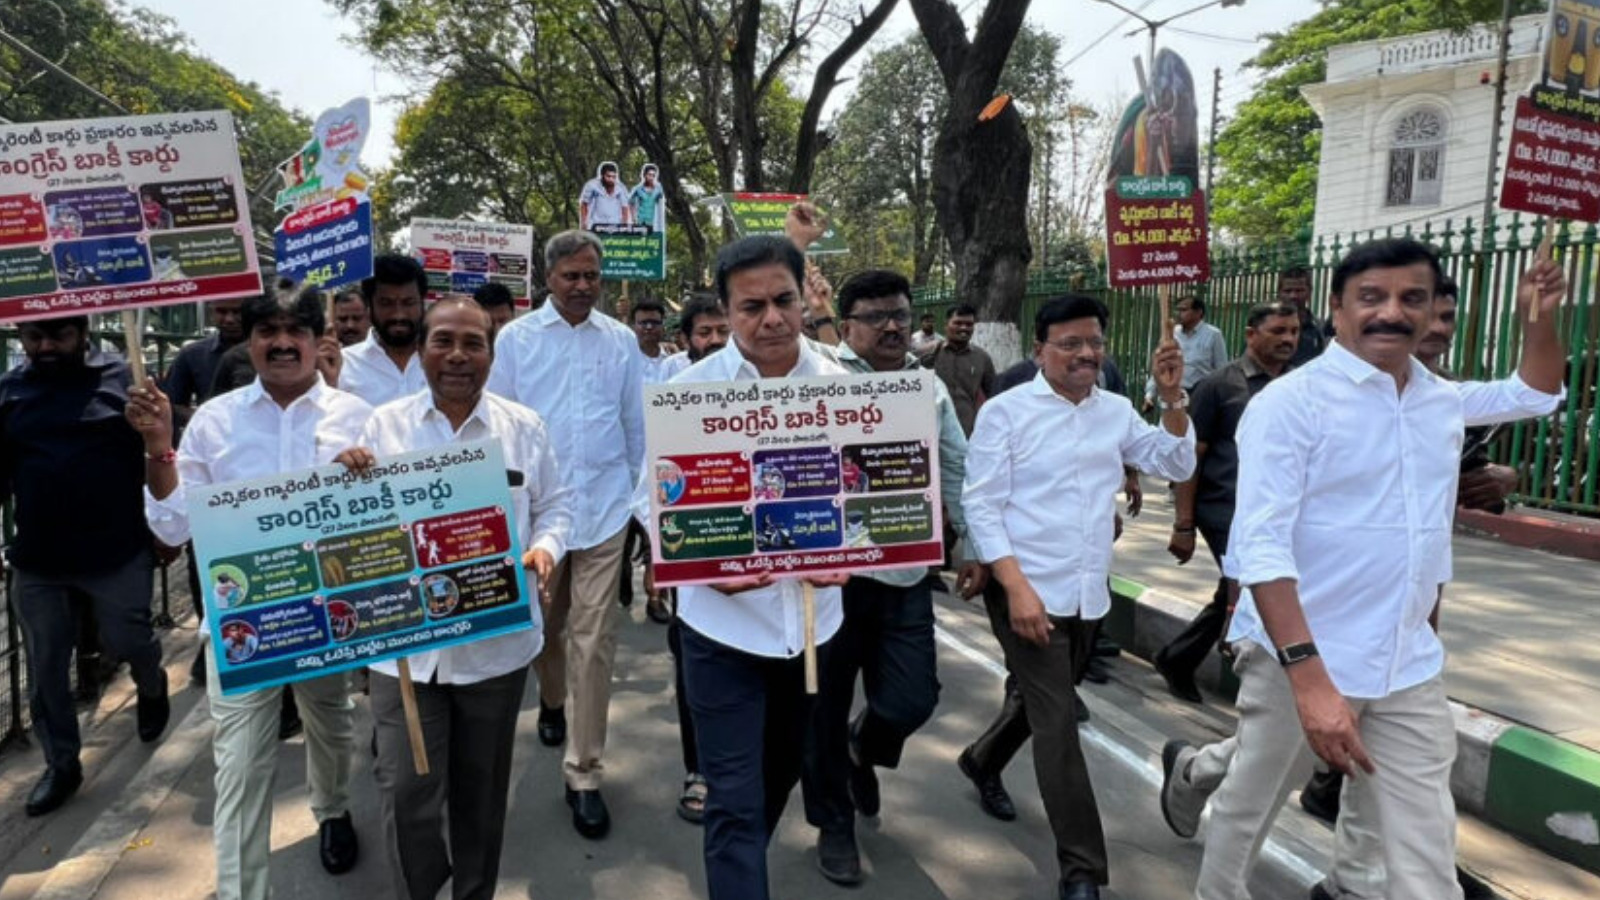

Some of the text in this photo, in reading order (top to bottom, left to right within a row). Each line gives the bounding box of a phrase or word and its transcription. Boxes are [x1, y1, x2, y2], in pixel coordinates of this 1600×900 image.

[46, 128, 80, 148] కార్డు
[85, 124, 137, 144] ప్రకారం
[141, 118, 218, 140] ఇవ్వవలసిన
[74, 141, 122, 170] బాకీ
[127, 143, 179, 172] కార్డు
[652, 379, 922, 410] ఎన్నికల గ్యారెంటీ కార్డు ప్రకారం ఇవ్వవలసిన
[701, 400, 883, 437] కాంగ్రెస్ బాకీ కార్డు
[208, 488, 261, 509] ఎన్నికల
[264, 472, 320, 500] గ్యారెంటీ
[412, 448, 486, 473] ఇవ్వవలసిన
[257, 478, 453, 532] కాంగ్రెస్ బాకీ కార్డు
